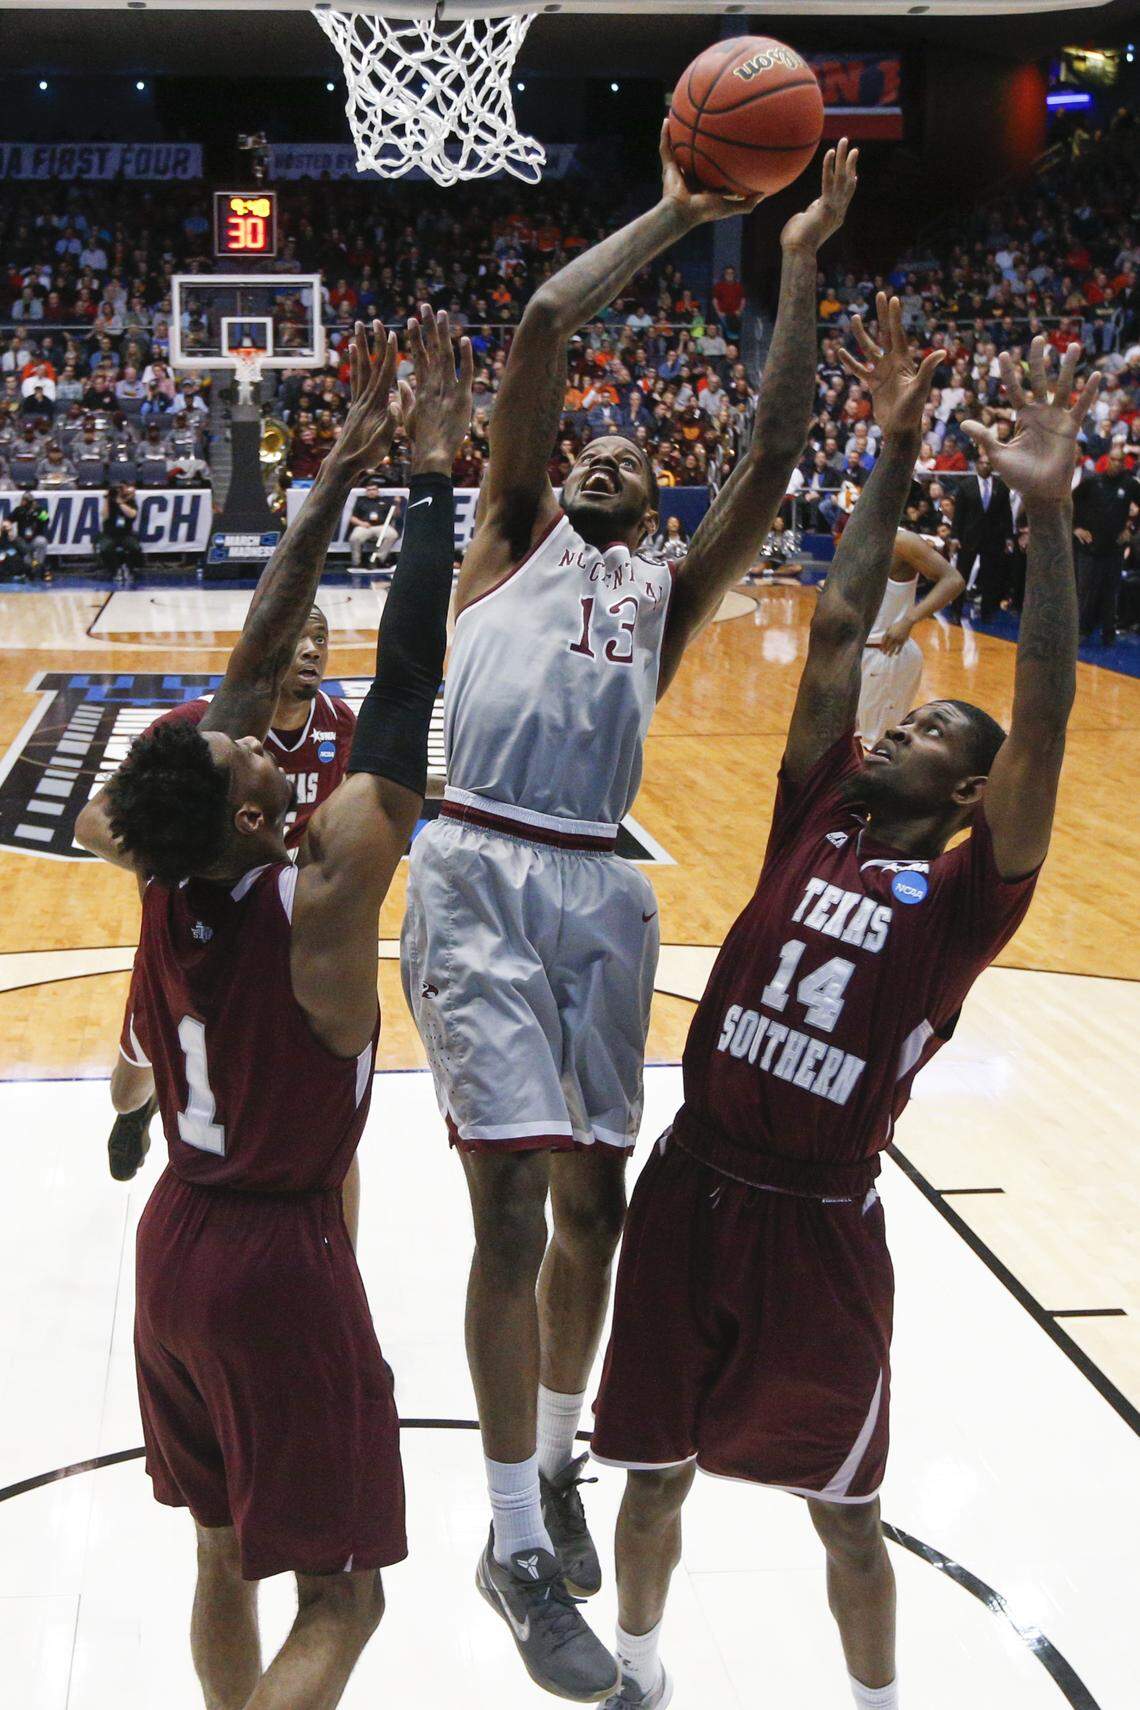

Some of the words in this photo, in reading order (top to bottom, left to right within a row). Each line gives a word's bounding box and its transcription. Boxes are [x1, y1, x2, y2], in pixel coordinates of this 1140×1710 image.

[33, 146, 111, 176] FIRST
[117, 144, 191, 176] FOUR
[226, 216, 265, 249] 30
[36, 495, 202, 544] MACH
[568, 596, 639, 665] 13
[791, 876, 893, 953] TEXAS
[895, 882, 924, 900] NCAA
[760, 938, 857, 1033] 14
[177, 1014, 226, 1157] 1
[717, 1003, 868, 1106] SOUTHERN
